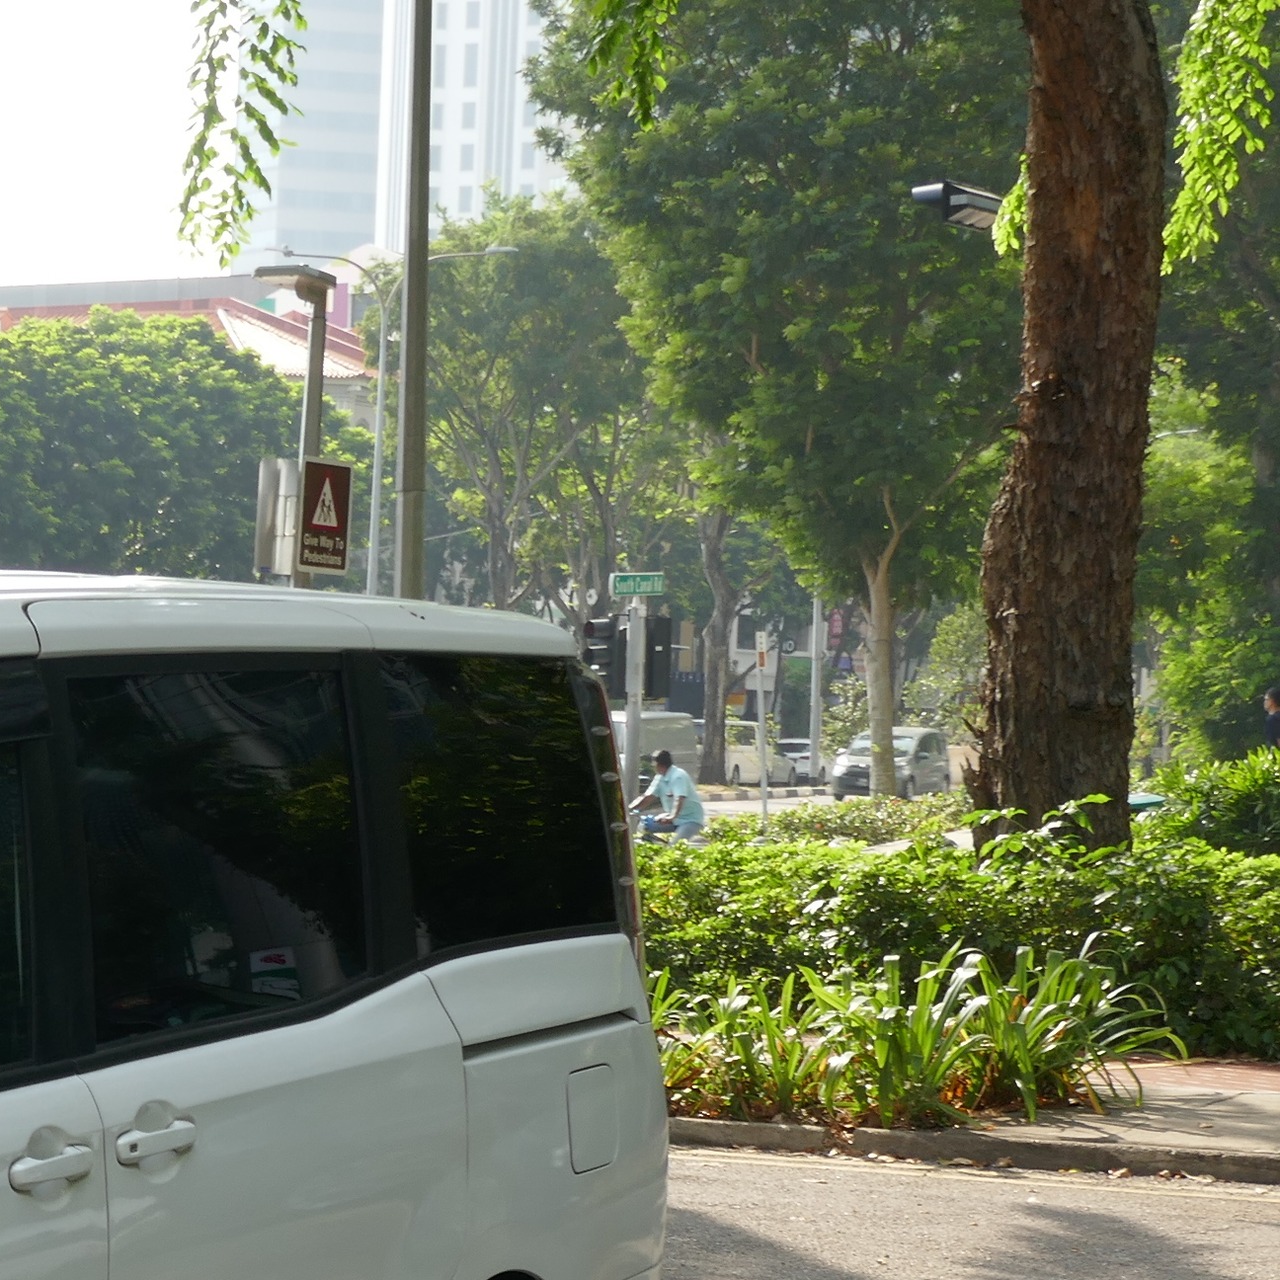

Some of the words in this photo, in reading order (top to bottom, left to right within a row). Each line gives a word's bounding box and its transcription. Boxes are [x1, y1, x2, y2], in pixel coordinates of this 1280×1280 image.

[303, 533, 319, 546] Give
[319, 535, 335, 552] Way
[335, 536, 345, 550] To
